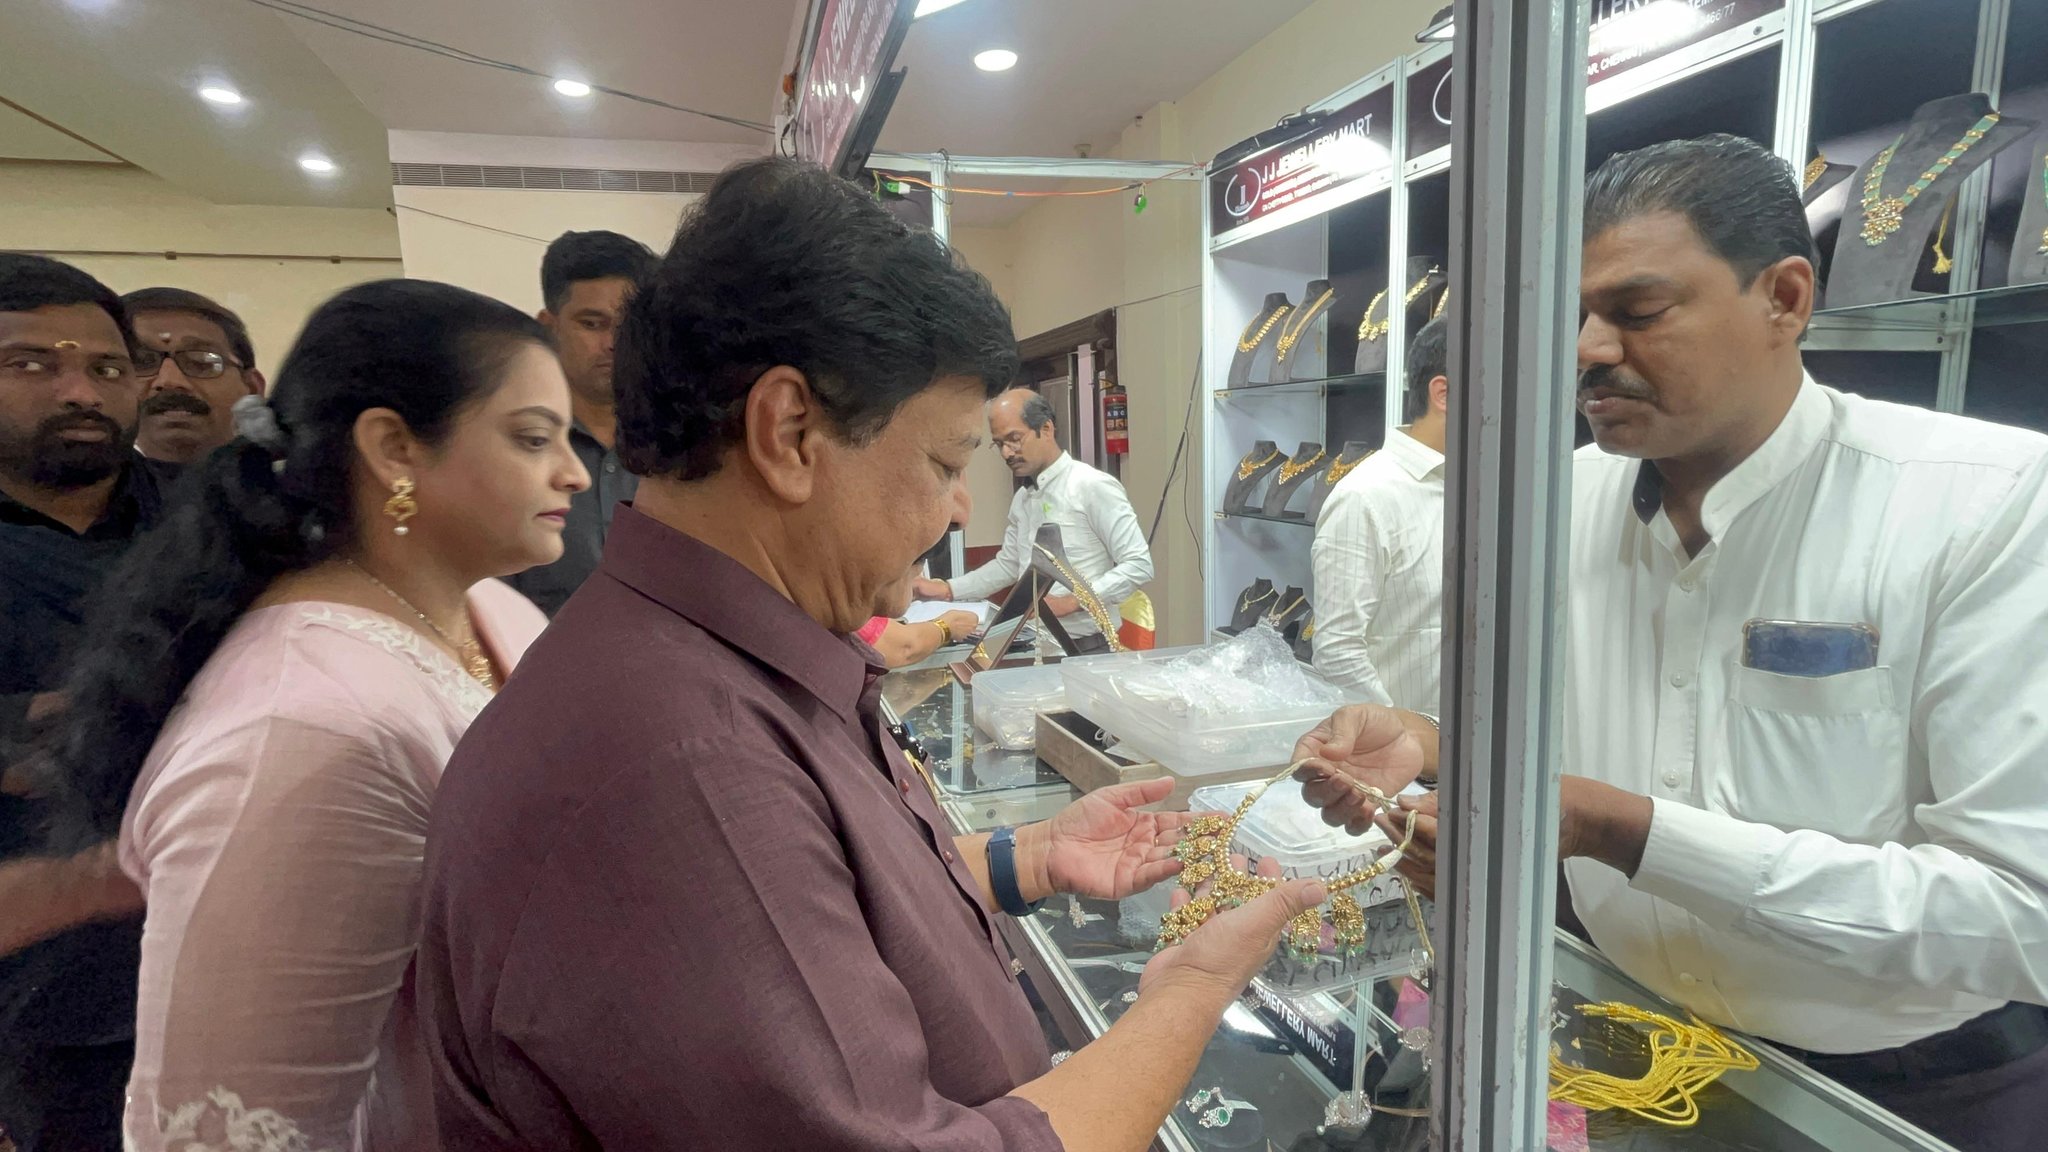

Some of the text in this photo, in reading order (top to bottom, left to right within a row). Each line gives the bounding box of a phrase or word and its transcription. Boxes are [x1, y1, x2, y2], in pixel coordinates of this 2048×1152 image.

[1262, 165, 1268, 184] J
[1269, 162, 1276, 181] J
[1339, 113, 1372, 139] MART
